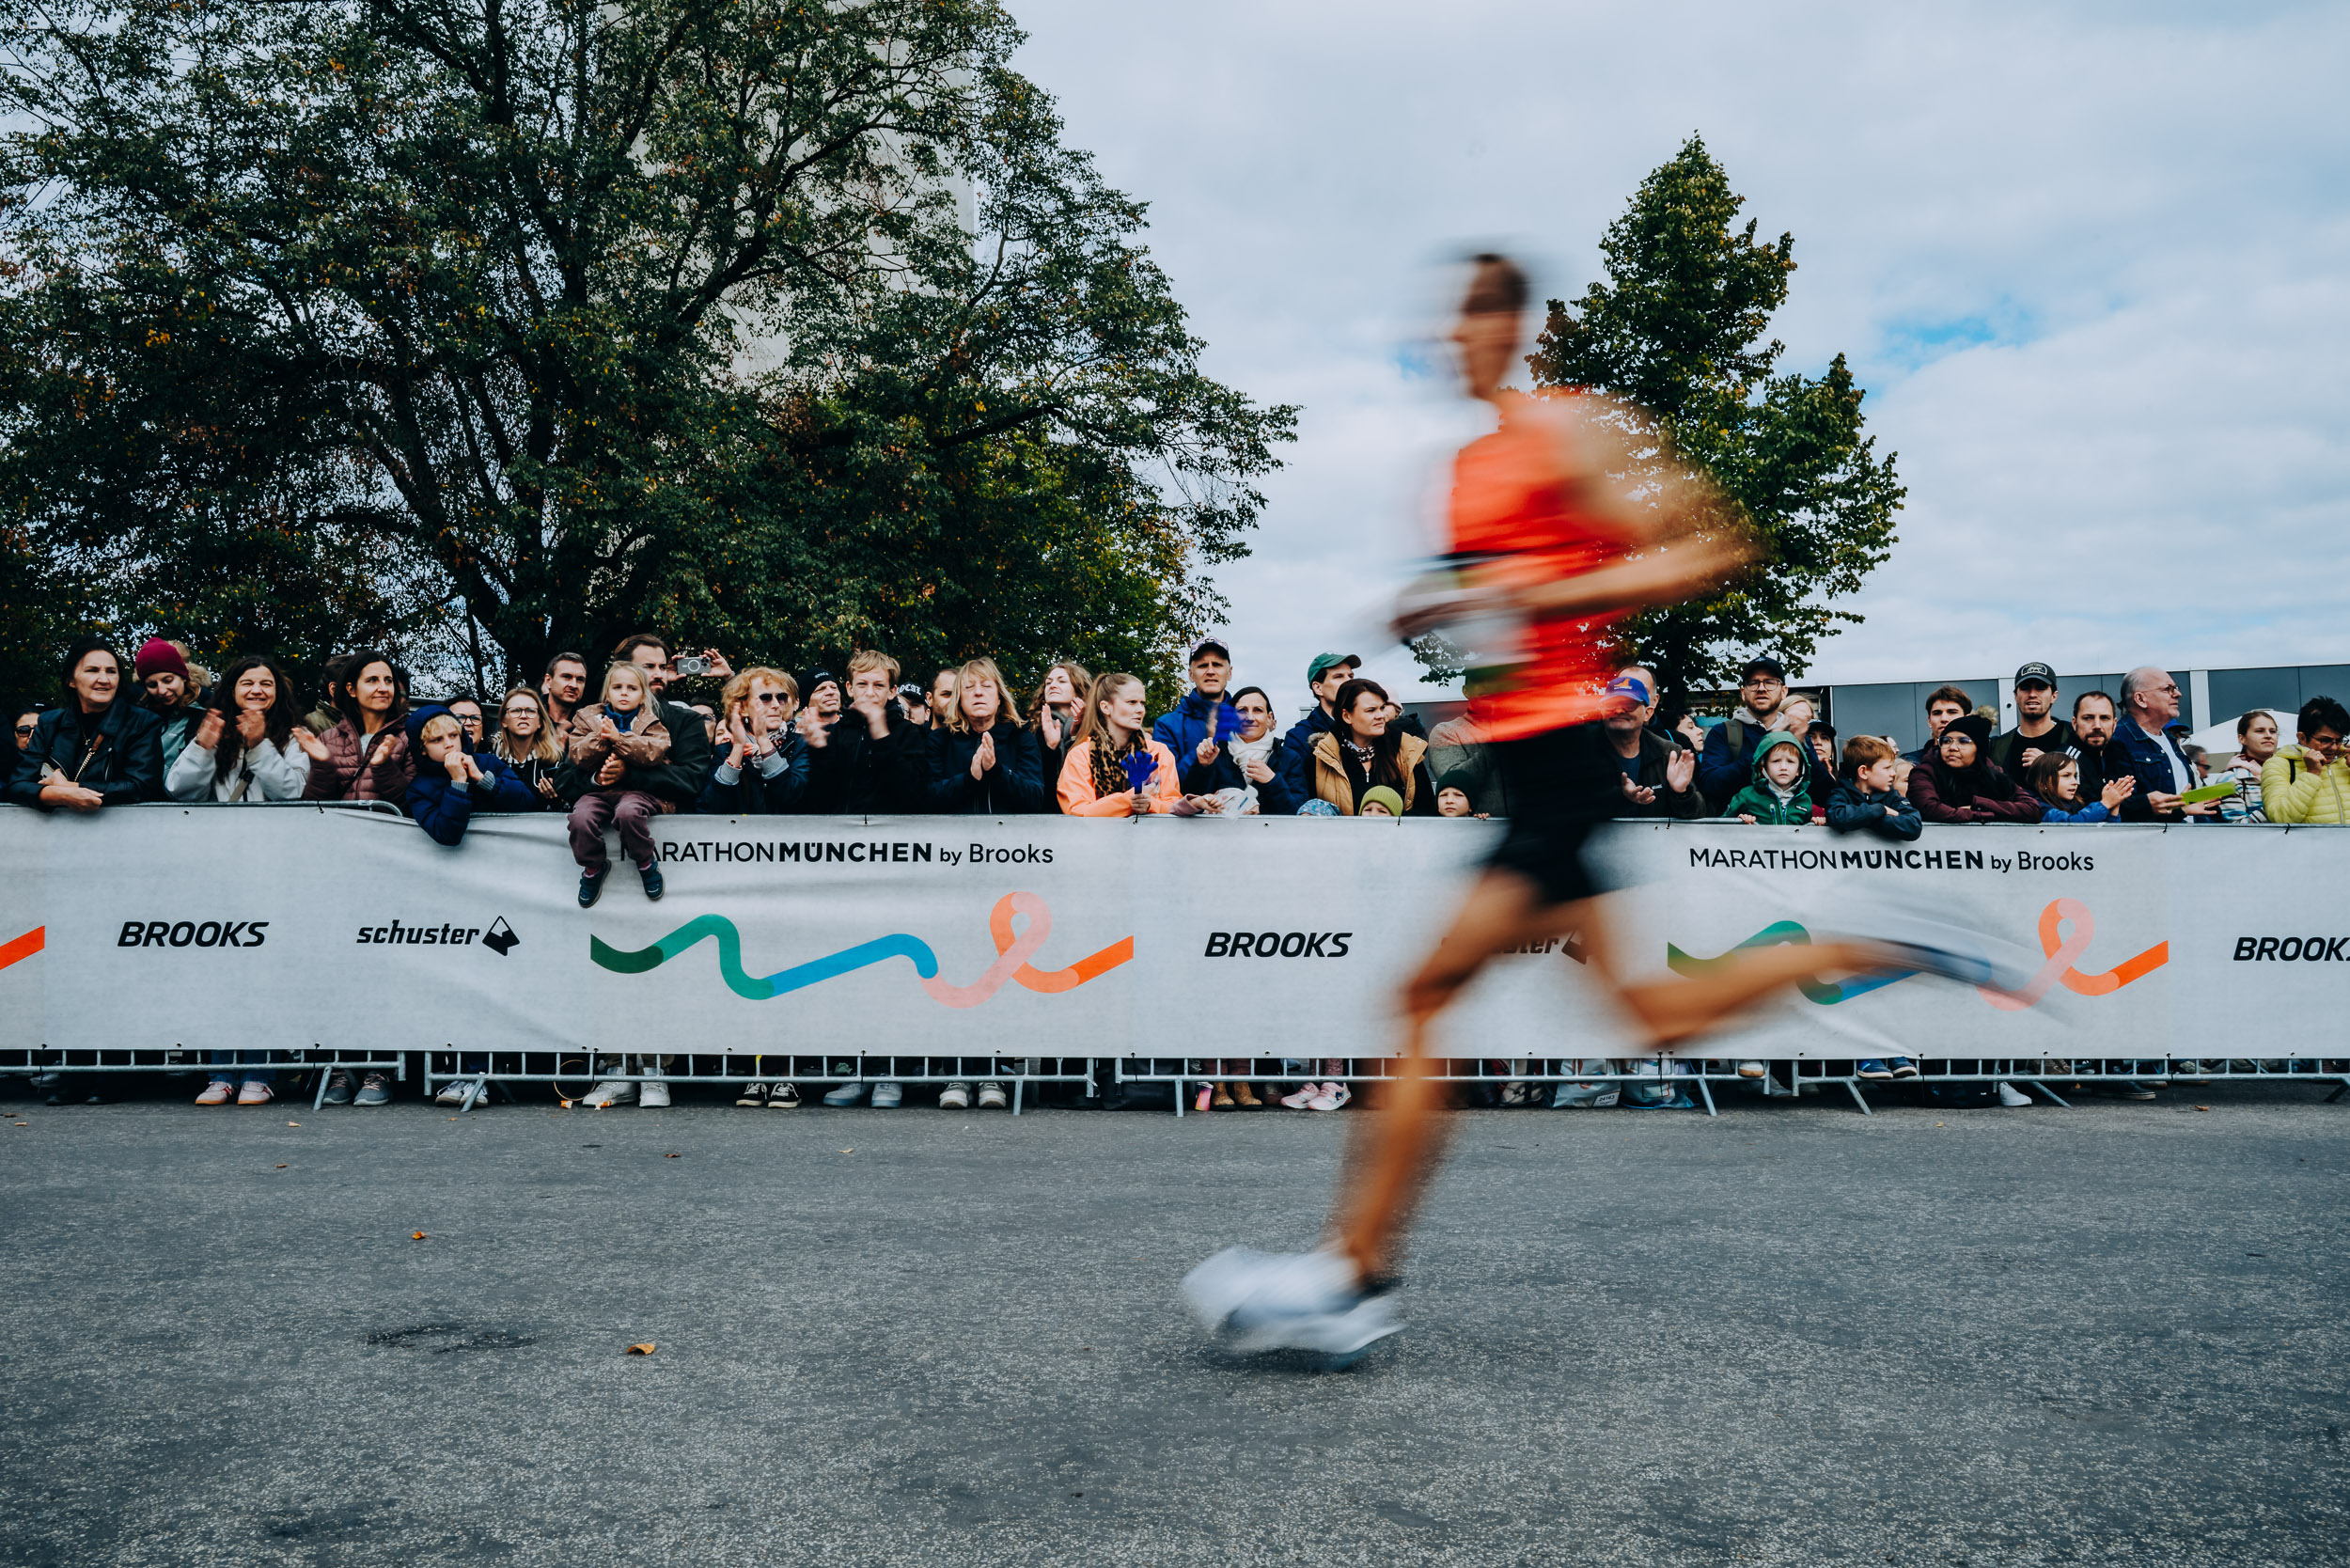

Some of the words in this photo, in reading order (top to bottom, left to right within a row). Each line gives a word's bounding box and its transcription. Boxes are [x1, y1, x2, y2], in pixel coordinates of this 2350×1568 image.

[939, 847, 963, 867] by
[969, 843, 1054, 864] Brooks
[1990, 855, 2013, 874] by
[2017, 851, 2094, 871] Brooks
[117, 920, 270, 948] BROOKS
[355, 918, 480, 946] schuster
[1204, 932, 1354, 958] BROOKS
[2232, 936, 2350, 962] BROOK
